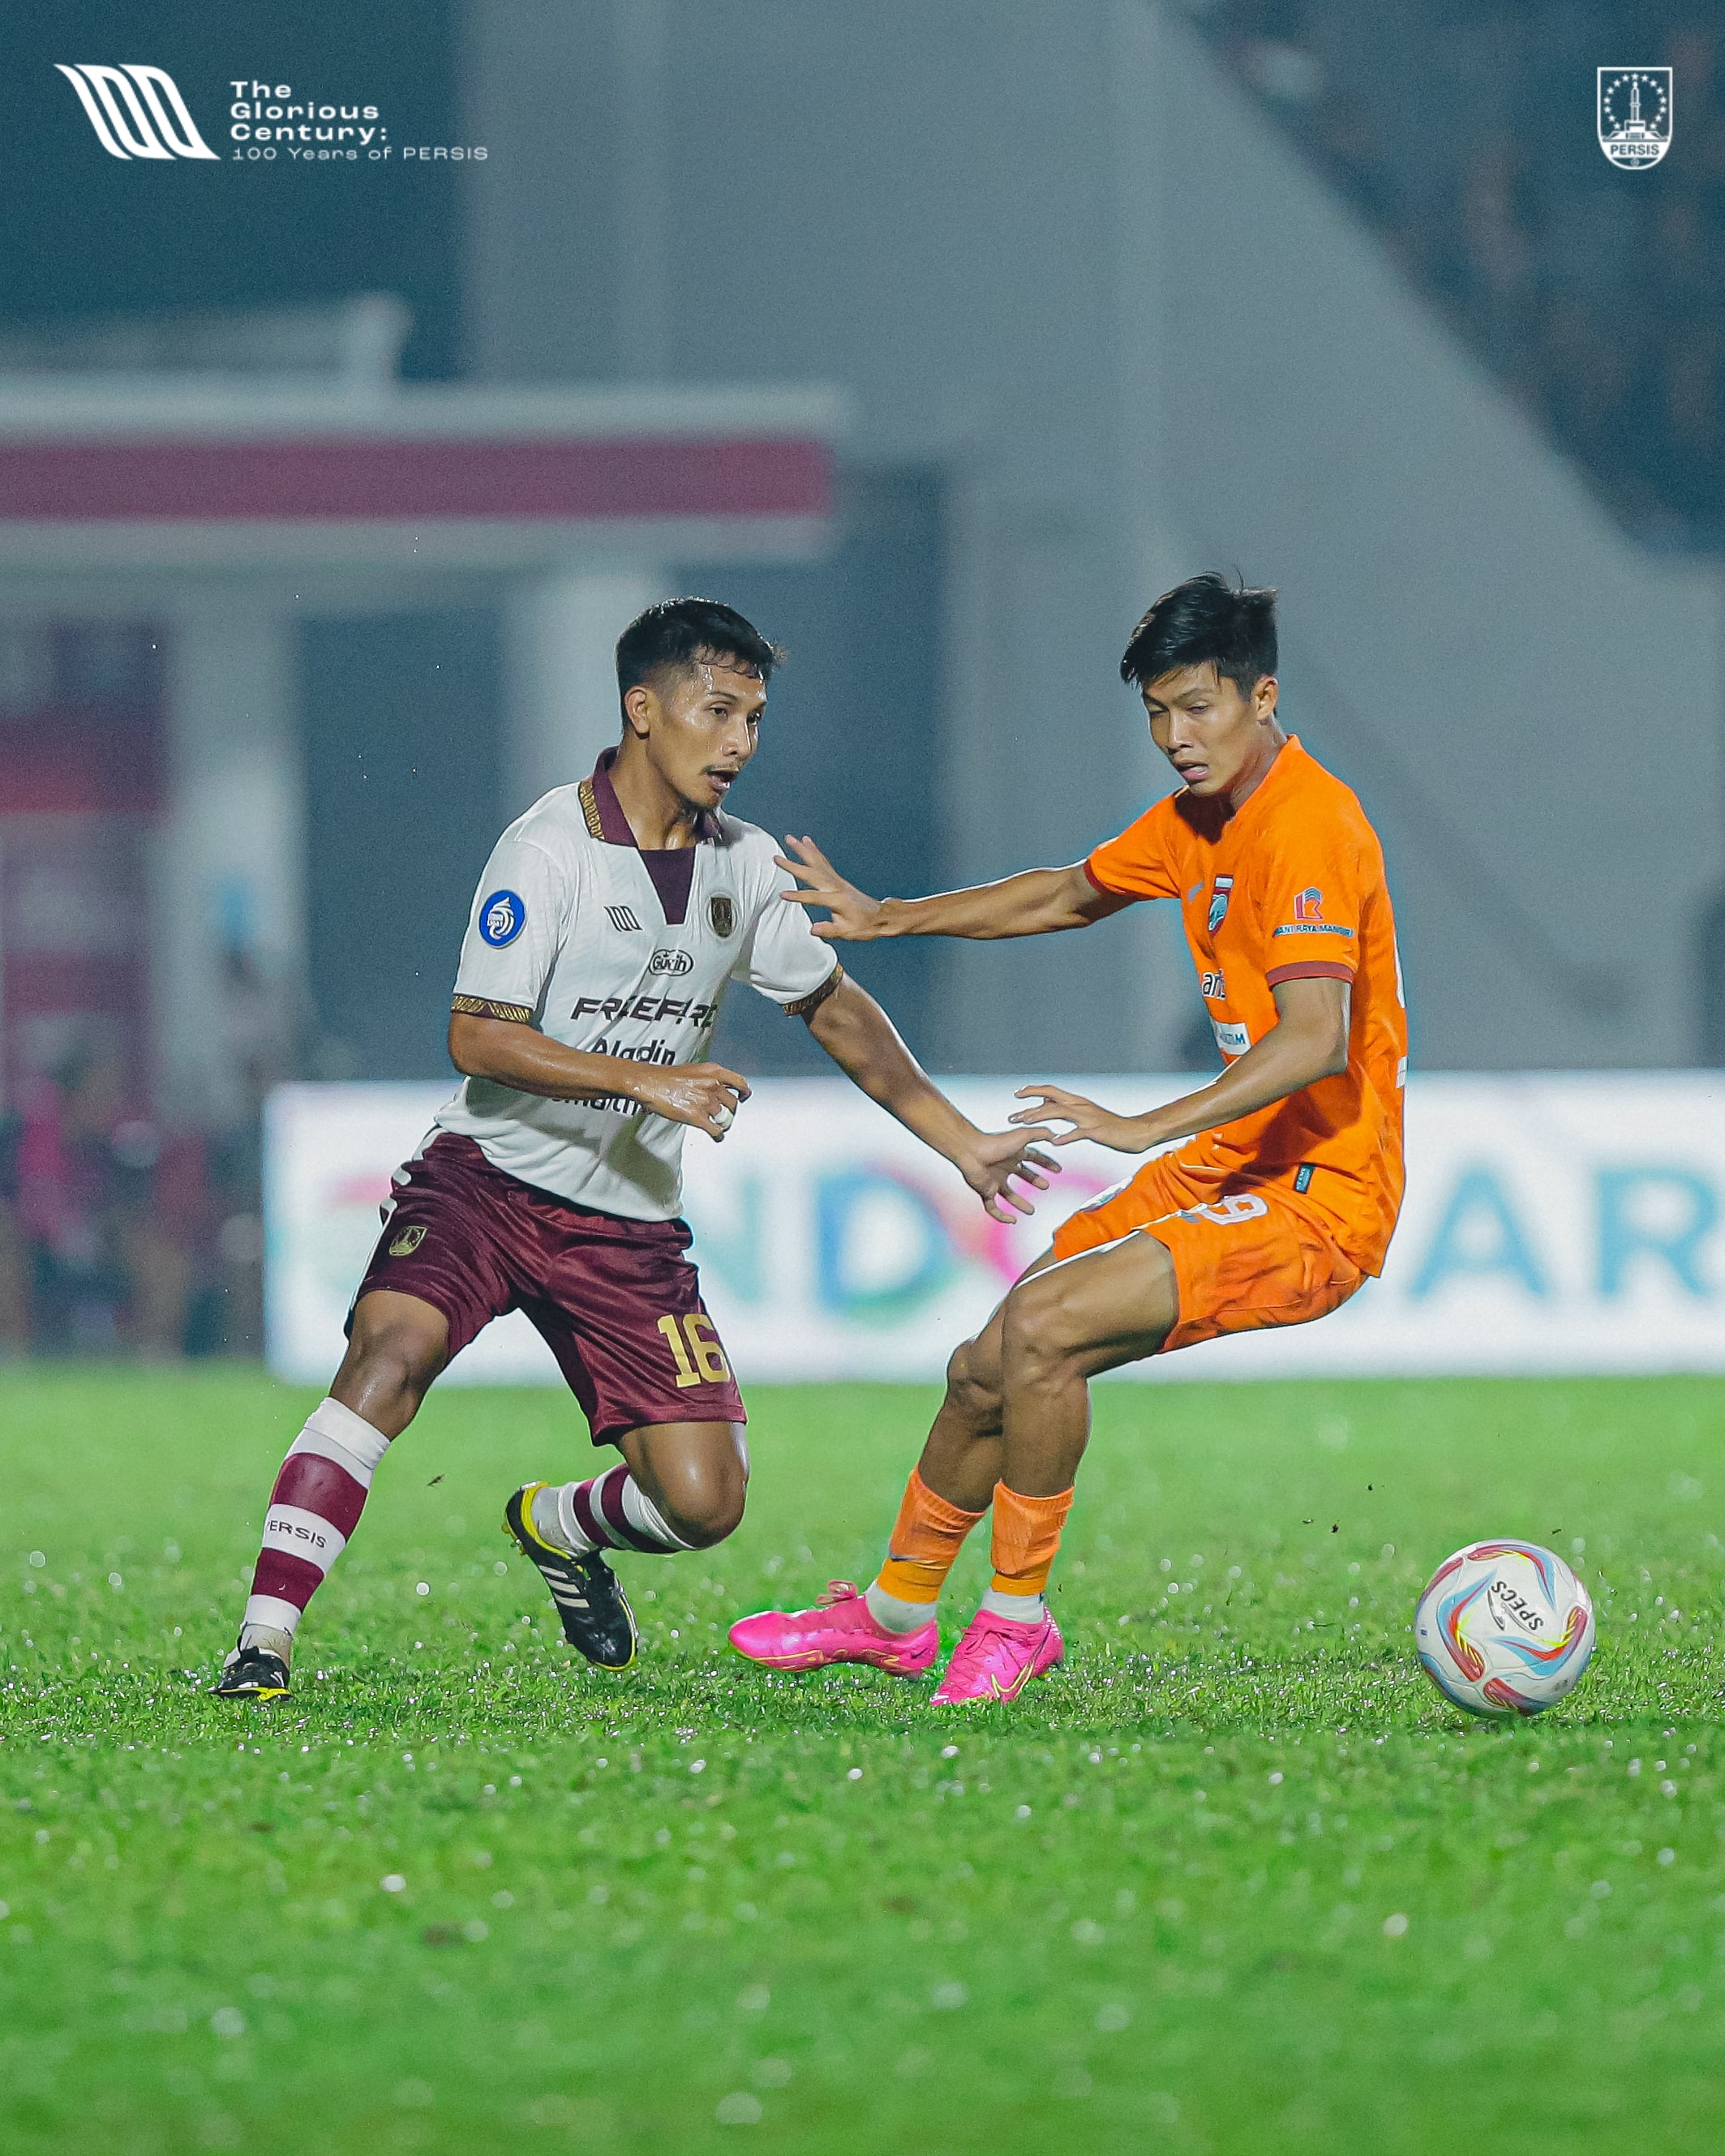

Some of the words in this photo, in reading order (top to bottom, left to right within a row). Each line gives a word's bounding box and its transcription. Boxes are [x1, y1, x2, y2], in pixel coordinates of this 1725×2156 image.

[590, 1037, 676, 1065] Aladin
[685, 1155, 1718, 1326] NDOAR
[657, 1313, 732, 1387] 16
[268, 1519, 327, 1548] ERSIS
[1491, 1580, 1544, 1631] SPECS
